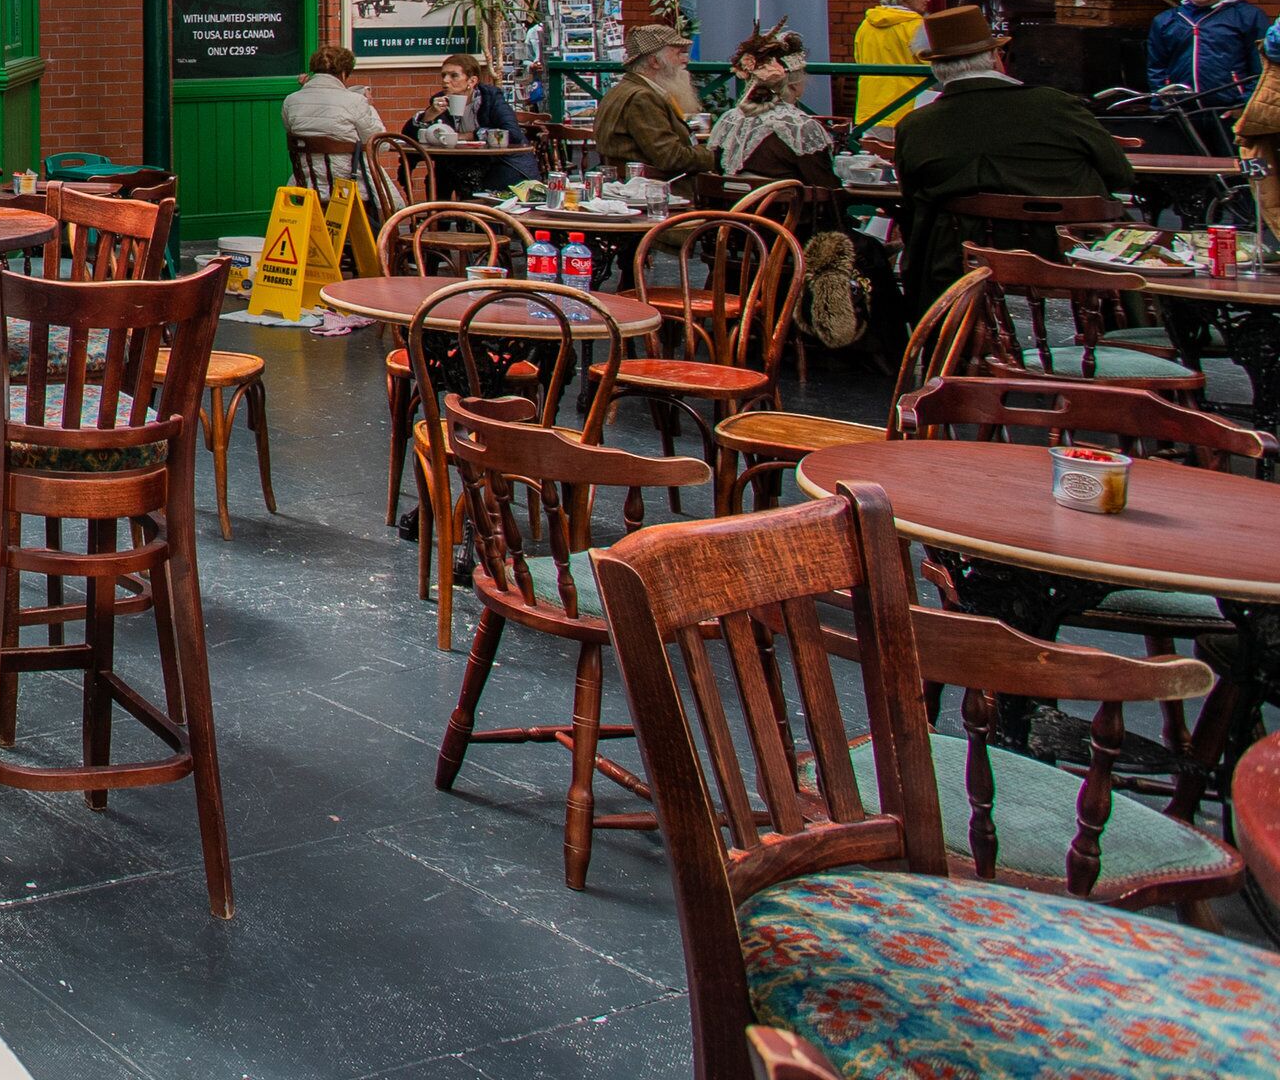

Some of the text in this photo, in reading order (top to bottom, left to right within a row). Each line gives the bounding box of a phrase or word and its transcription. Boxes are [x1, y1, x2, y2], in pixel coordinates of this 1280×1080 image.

[183, 13, 282, 23] WITH UNLIMITED SHIPPING
[192, 31, 203, 40] TO
[223, 30, 234, 39] EU
[235, 30, 242, 39] &
[242, 30, 275, 39] CANADA
[363, 39, 378, 47] THE
[381, 39, 402, 47] TURN
[405, 38, 415, 46] OF
[418, 38, 433, 46] THE
[207, 47, 228, 56] ONLY
[1239, 158, 1261, 174] 15
[262, 263, 290, 275] CLEANING
[290, 268, 297, 276] IN
[263, 275, 293, 286] PROGRESS
